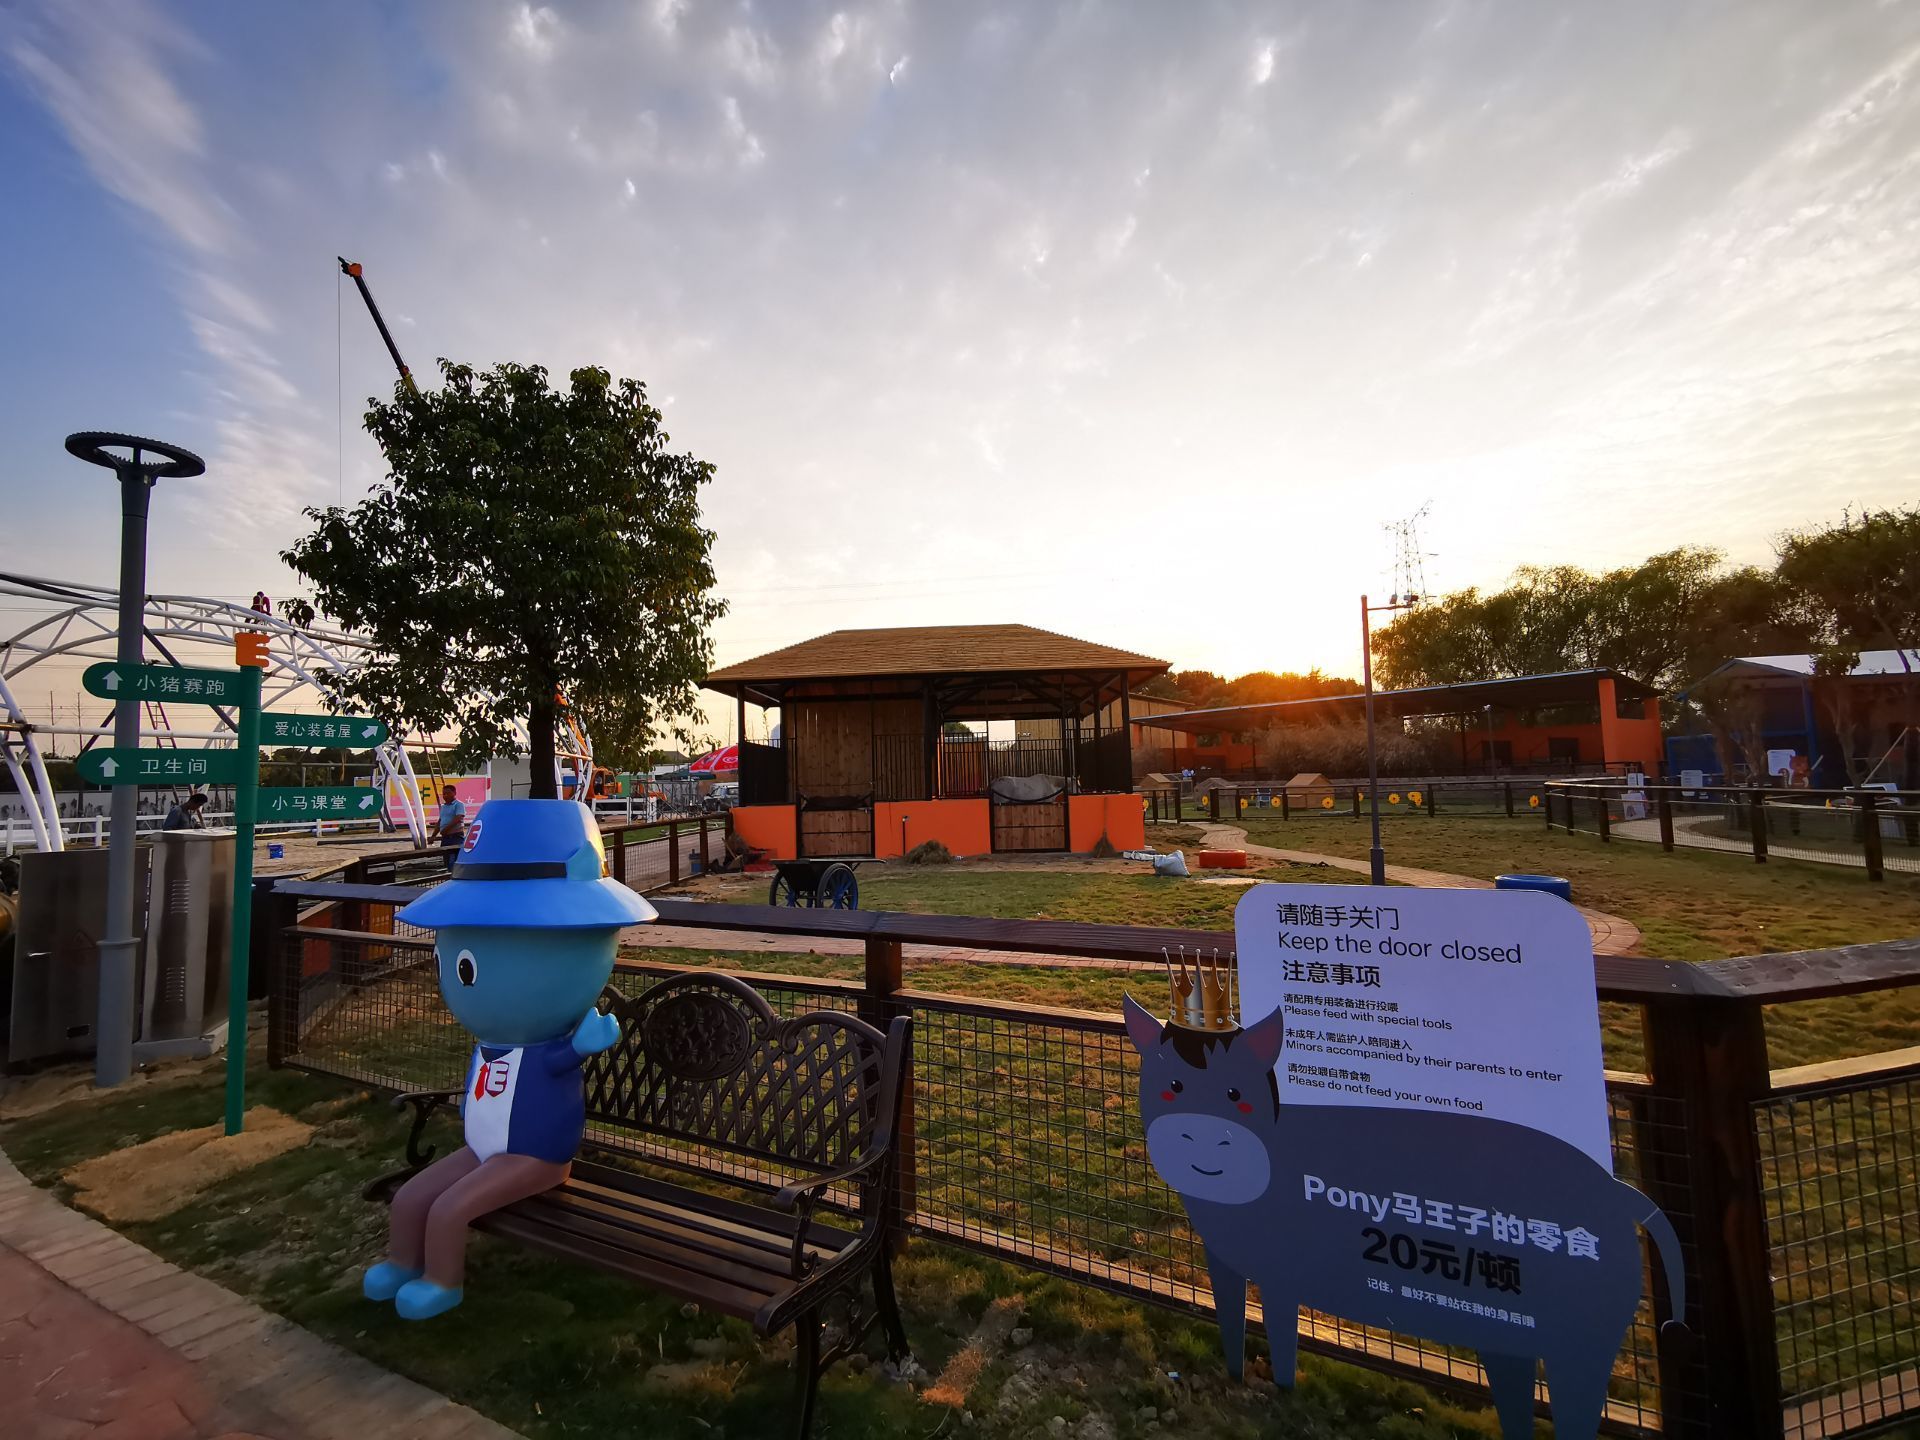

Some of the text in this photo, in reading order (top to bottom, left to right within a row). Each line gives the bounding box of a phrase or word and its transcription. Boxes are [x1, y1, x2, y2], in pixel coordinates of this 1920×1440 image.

[136, 675, 225, 697] 小猪赛跑
[274, 720, 352, 739] 爱心装备屋
[139, 758, 207, 776] 卫生间
[271, 794, 347, 812] 小马课堂
[1276, 903, 1400, 931] 请随手关门
[1278, 931, 1522, 964] Keep the door closed
[1282, 960, 1381, 988] 注意事项
[1283, 993, 1399, 1013] 请配用专用装备进行投喂
[1284, 1005, 1453, 1030] Please feed with special tools
[1285, 1028, 1413, 1051] 未成年人需监护人陪同进入
[1286, 1040, 1563, 1082] Minors accompanied by their parents to enter
[1287, 1062, 1371, 1083] 请勿投喂自带食物
[1288, 1074, 1483, 1111] Please do not feed your own food
[1303, 1174, 1600, 1262] Pony马王子的零食
[1360, 1226, 1522, 1296] 20元/顿
